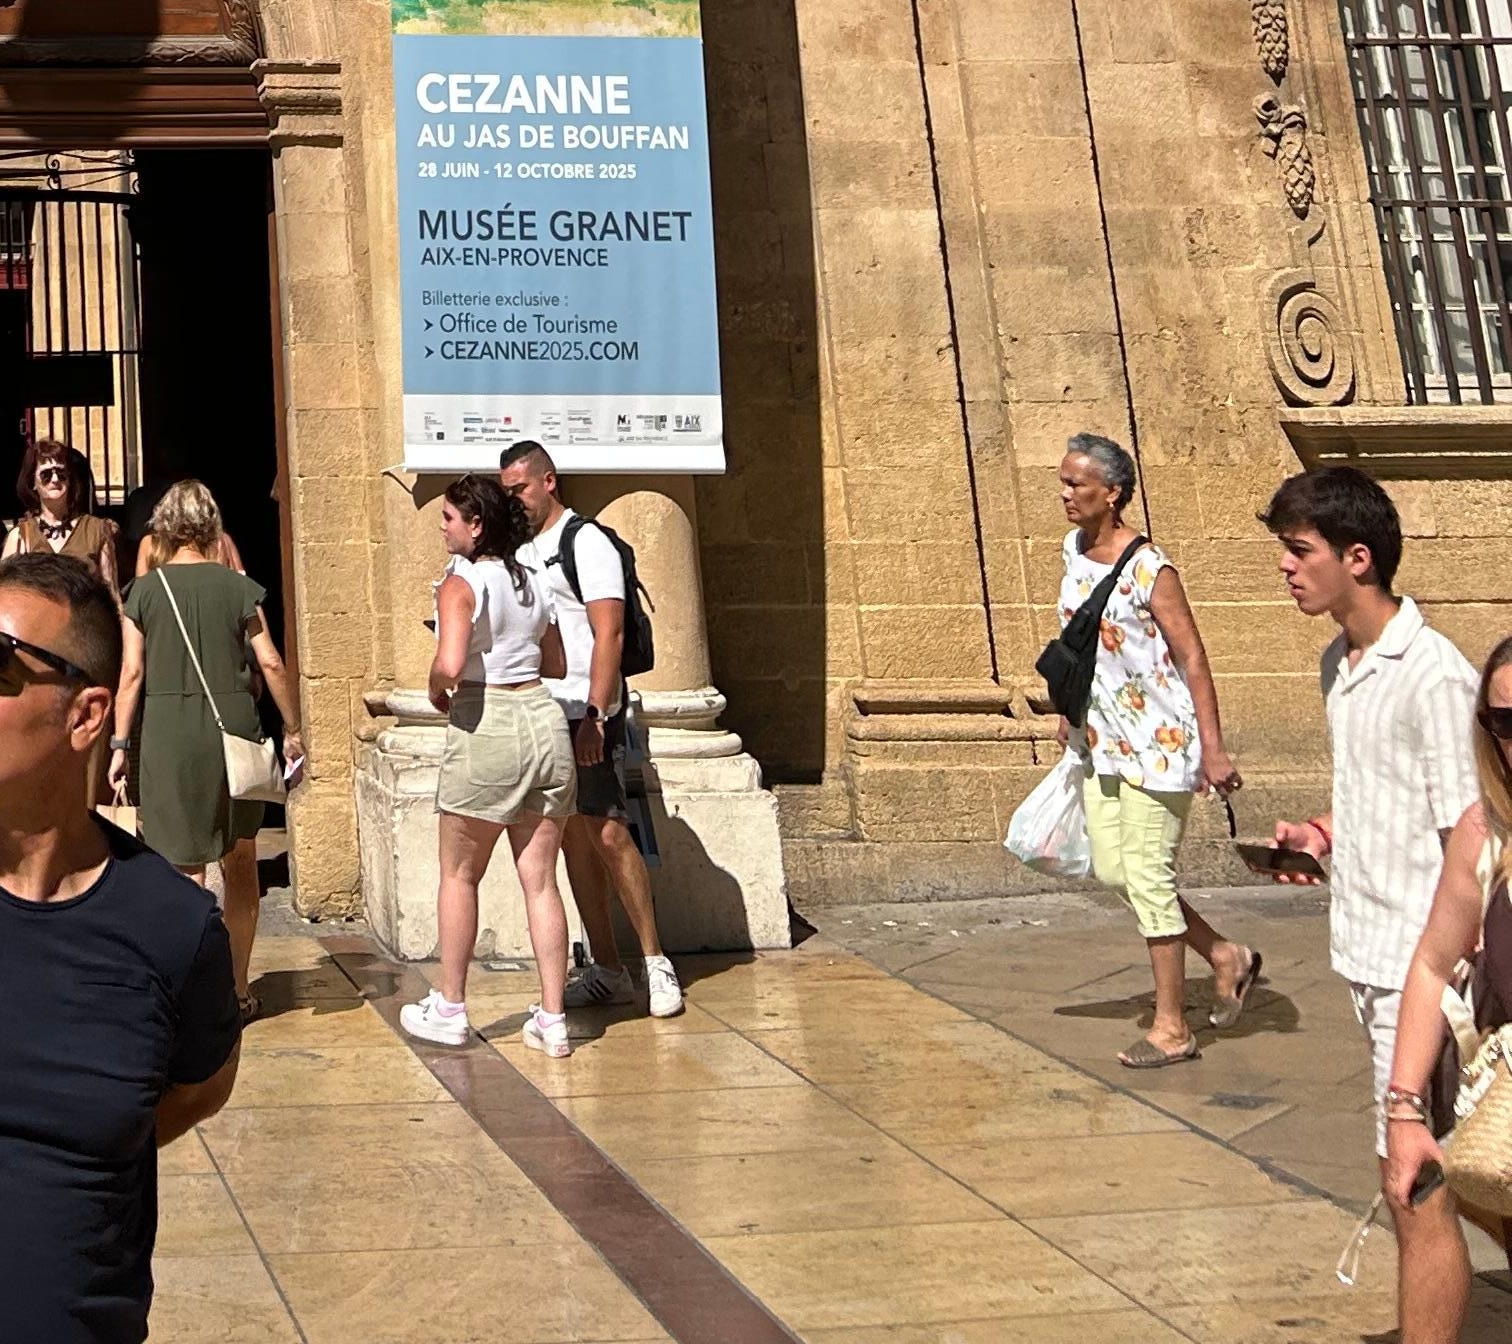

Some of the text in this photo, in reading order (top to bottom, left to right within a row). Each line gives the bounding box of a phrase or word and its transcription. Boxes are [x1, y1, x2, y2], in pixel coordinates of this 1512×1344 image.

[416, 72, 631, 116] CEZANNE
[416, 123, 689, 150] AU JAS DE BOUFFAN
[418, 160, 438, 179] 28
[441, 162, 480, 178] JUIN
[495, 162, 513, 178] 12
[517, 162, 595, 180] OCTOBRE
[599, 163, 637, 179] 2025
[418, 202, 693, 242] MUSÉE GRANET
[420, 246, 609, 267] AIX-EN-PROVENCE
[422, 290, 491, 307] Billetterie
[495, 290, 560, 307] exclusive
[439, 311, 618, 334] Office de Tourisme
[440, 340, 639, 361] CEZANNE2025.COM
